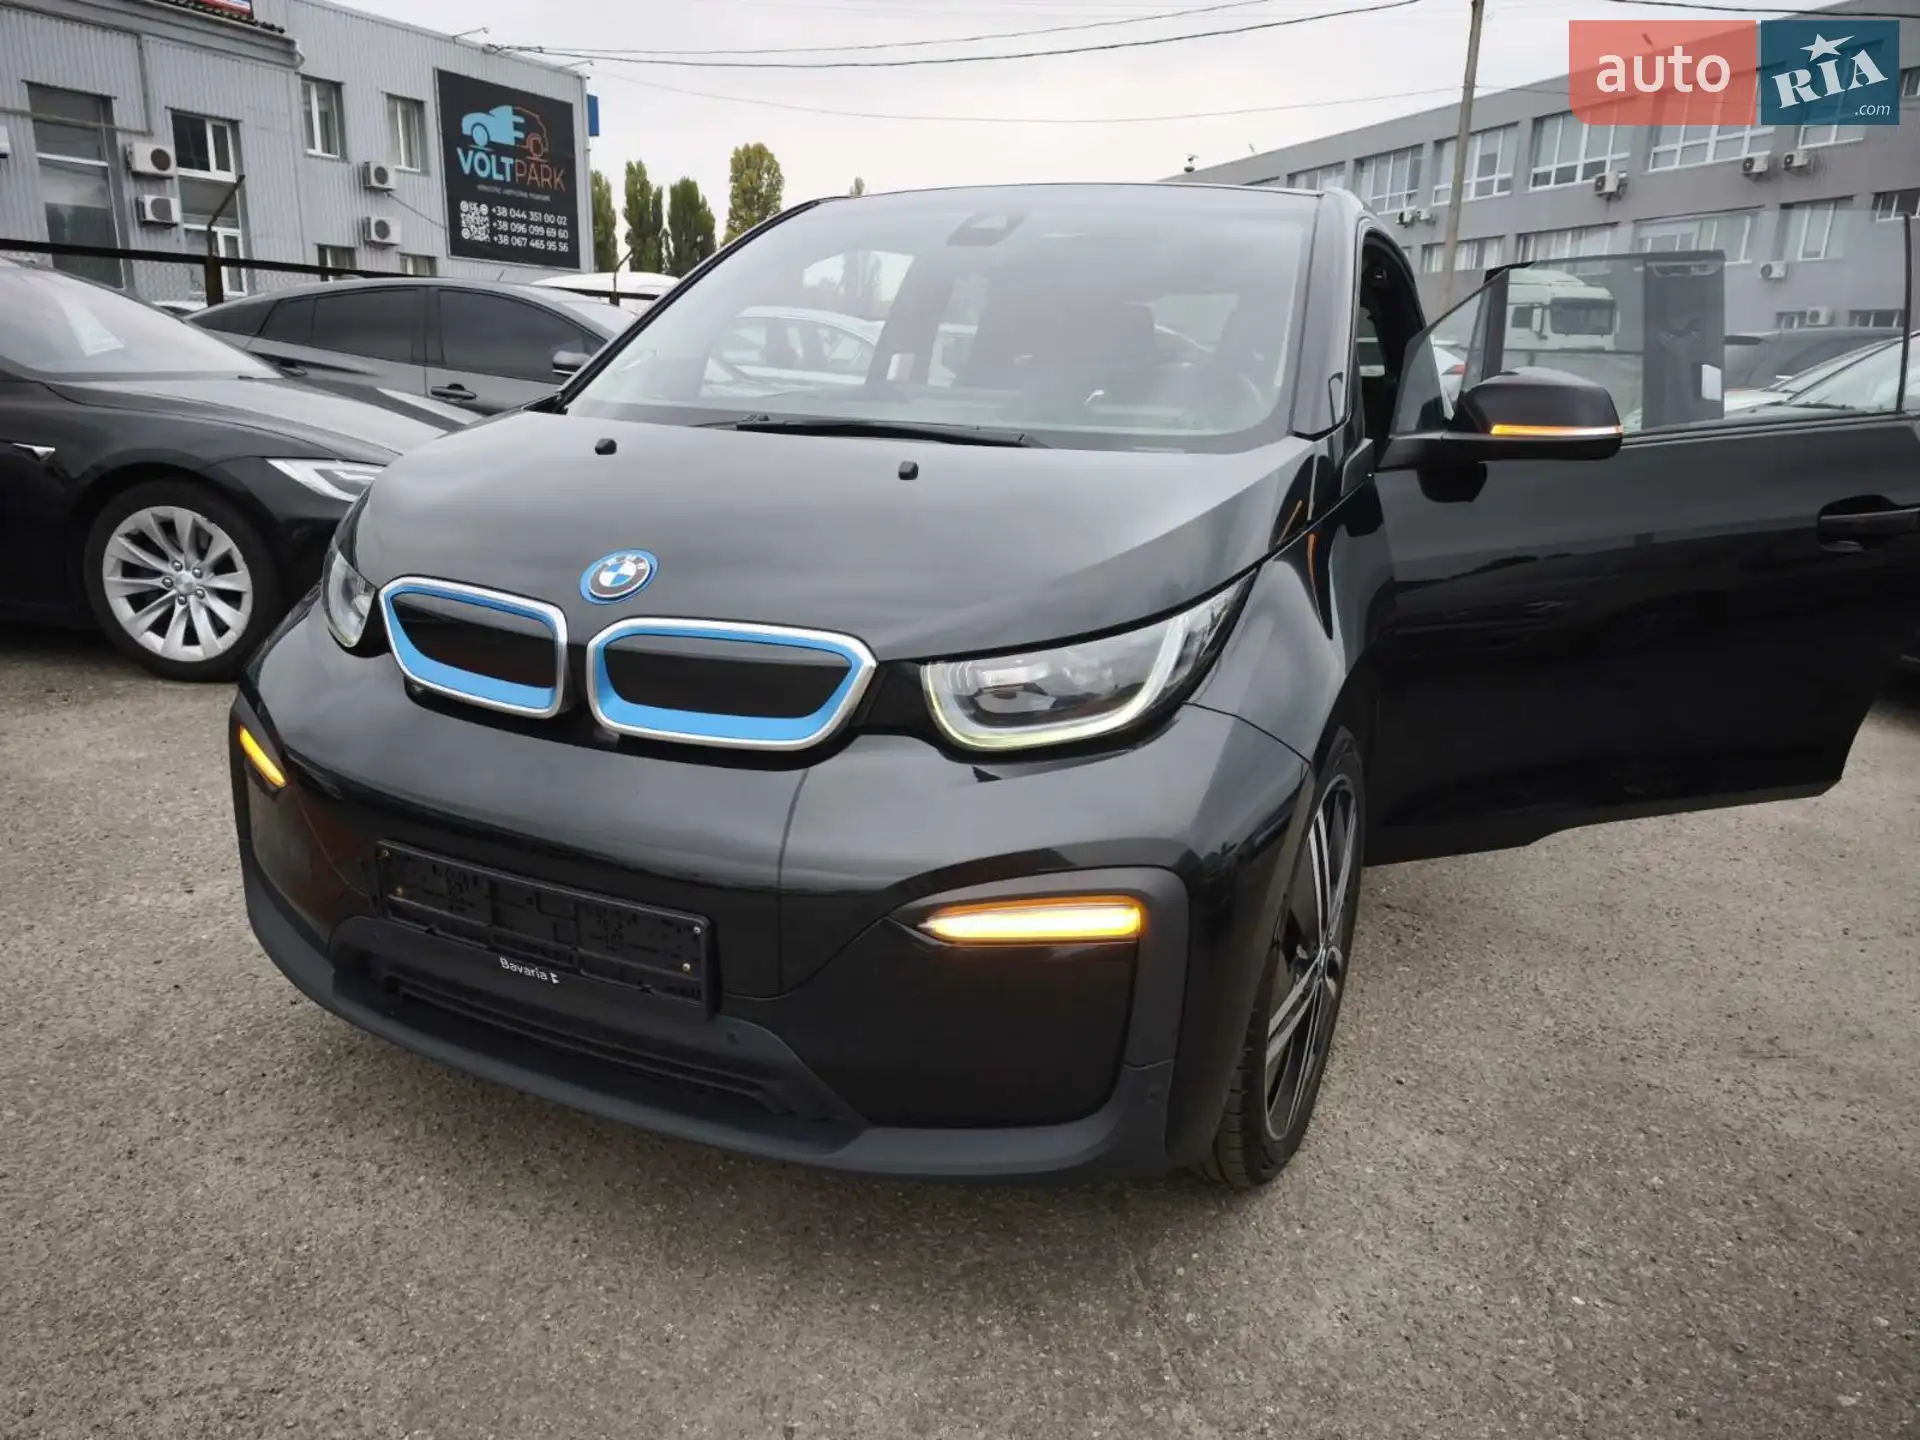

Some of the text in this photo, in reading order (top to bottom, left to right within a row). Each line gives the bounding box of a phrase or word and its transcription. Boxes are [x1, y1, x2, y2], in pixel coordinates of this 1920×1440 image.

[456, 147, 566, 192] VOLTPARK
[491, 205, 568, 226] +38 044 351 00 02
[492, 220, 509, 231] +38
[510, 221, 527, 234] 096
[528, 224, 545, 236] 099
[546, 227, 557, 238] 69
[492, 234, 509, 245] +38
[510, 236, 528, 247] 067
[558, 242, 569, 252] 56
[499, 956, 548, 981] Bavaria
